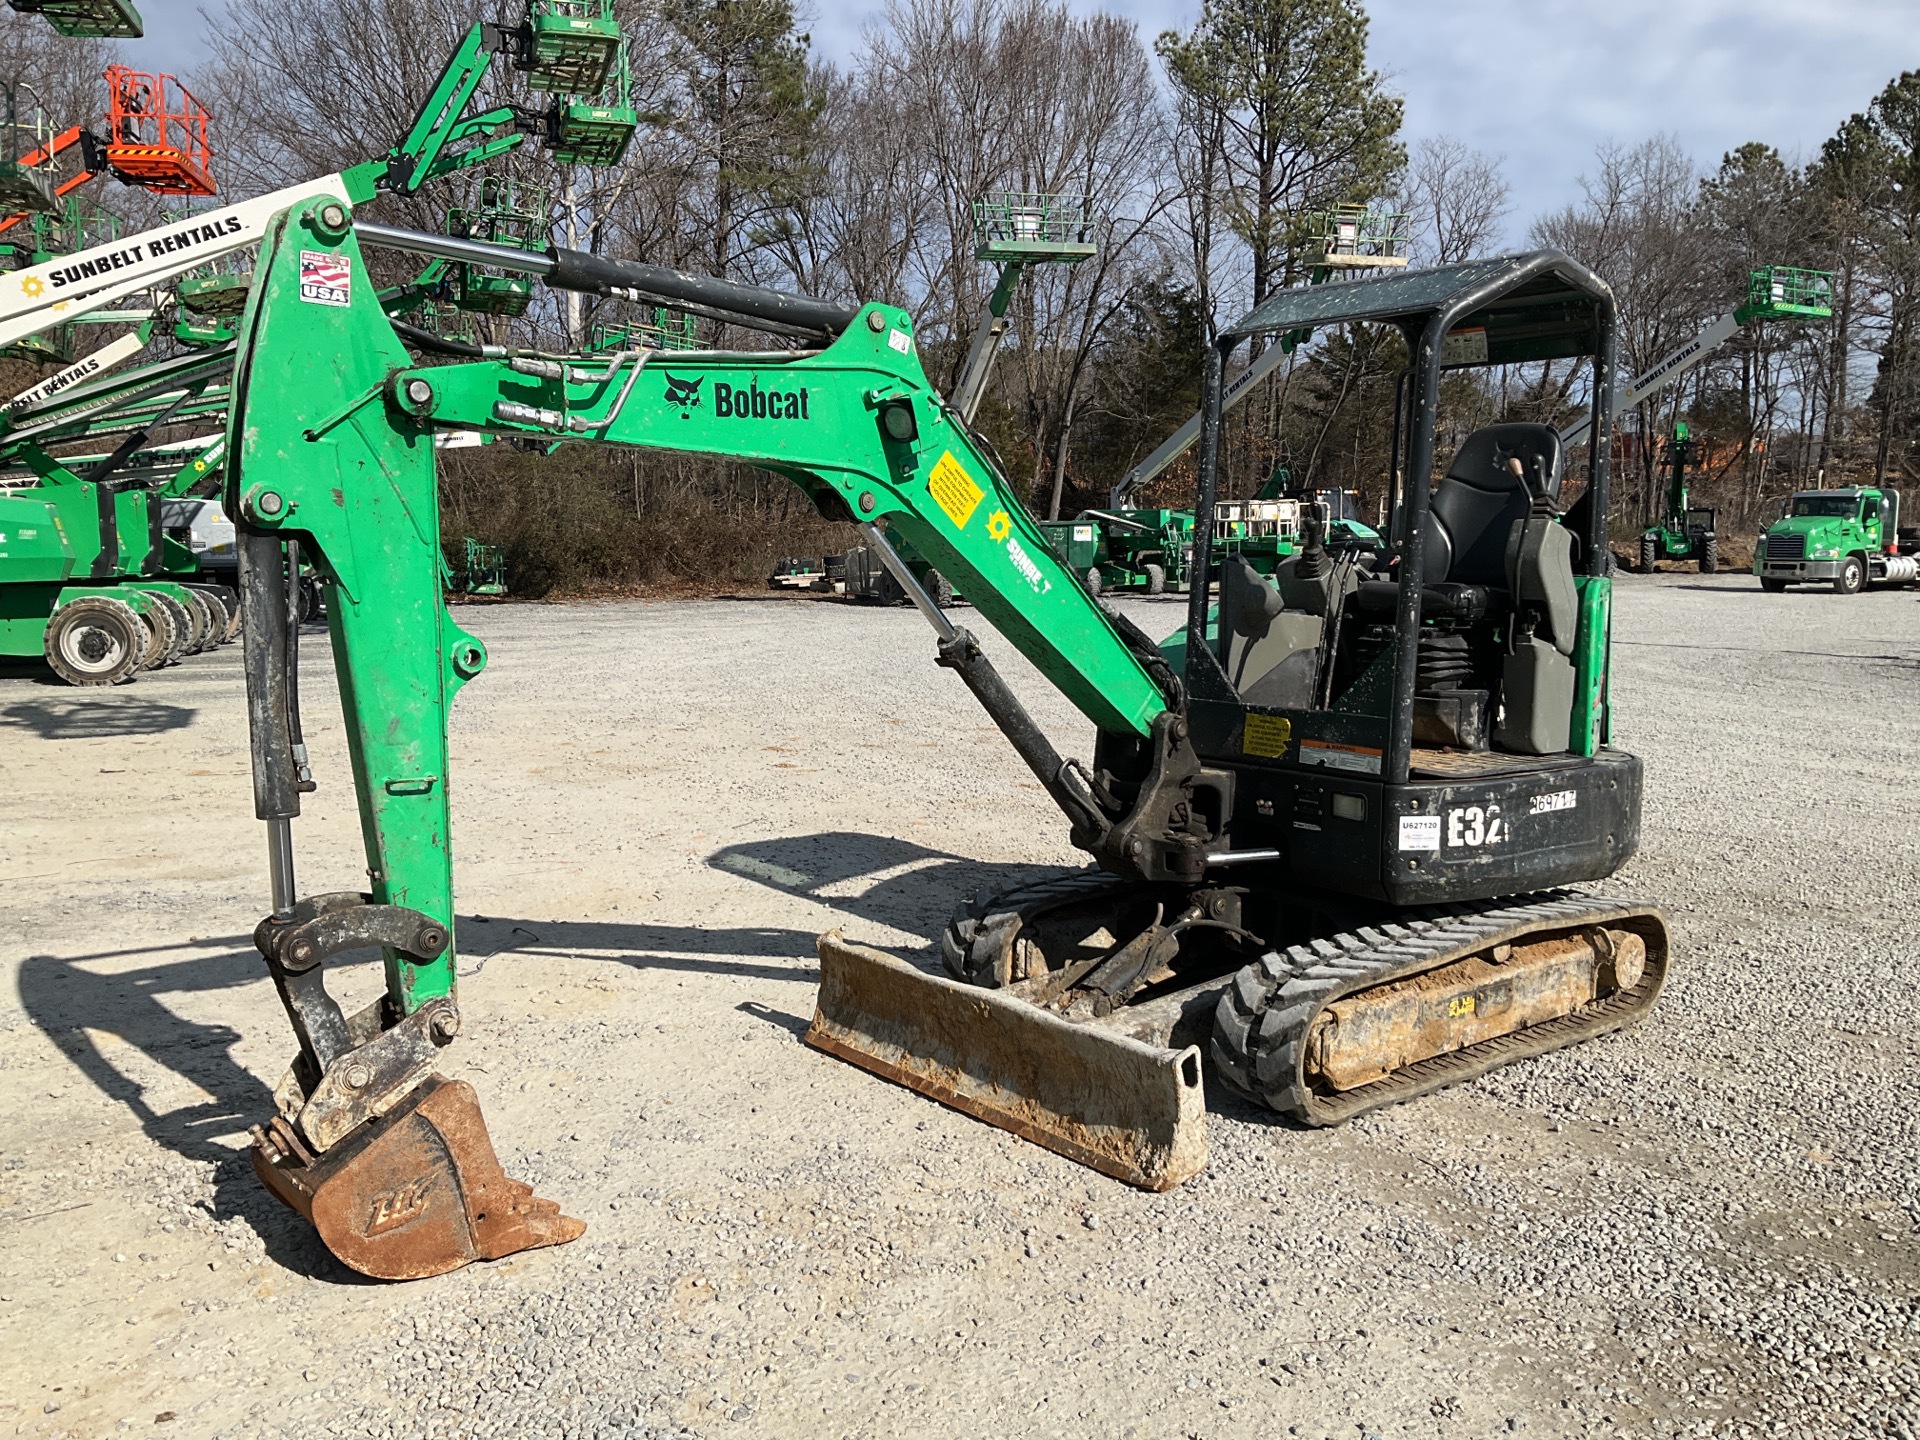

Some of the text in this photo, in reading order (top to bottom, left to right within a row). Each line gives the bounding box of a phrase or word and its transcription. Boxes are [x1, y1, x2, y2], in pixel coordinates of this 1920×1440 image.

[49, 216, 242, 288] SUNBELT RENTALS
[304, 284, 347, 303] USA
[1634, 341, 1701, 392] SUNBELT RENTALS
[714, 382, 810, 420] Bobcat
